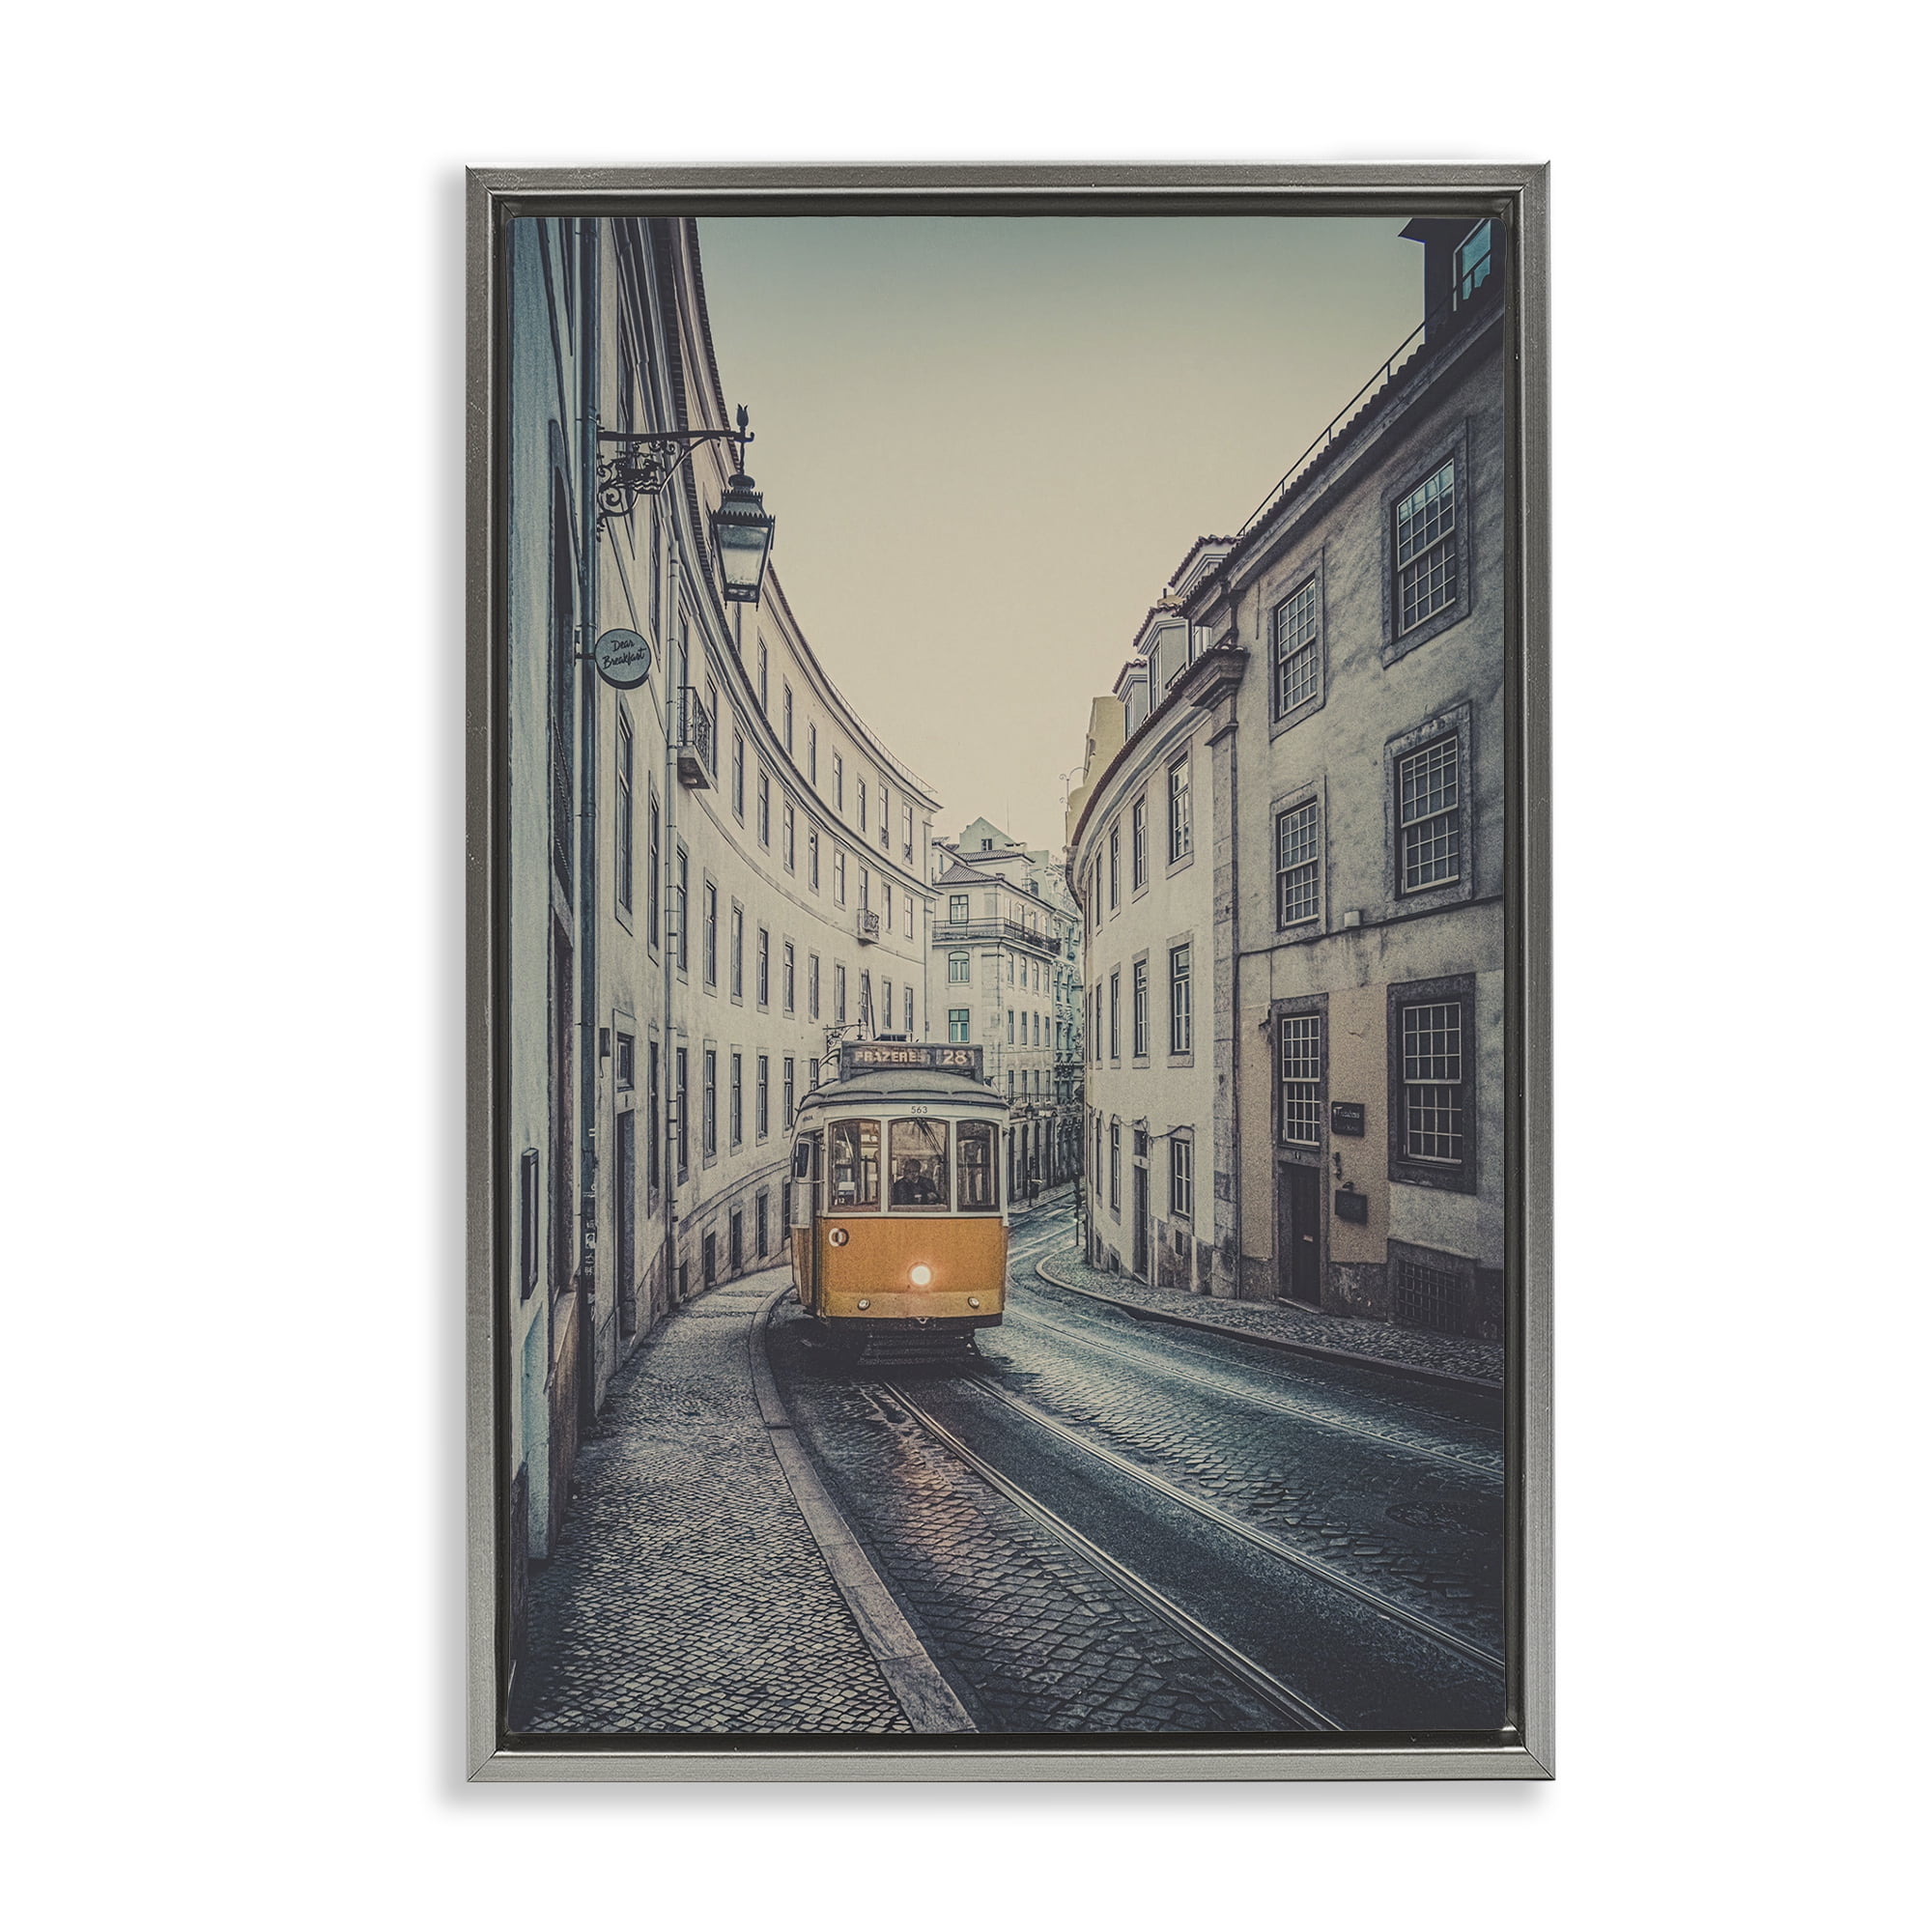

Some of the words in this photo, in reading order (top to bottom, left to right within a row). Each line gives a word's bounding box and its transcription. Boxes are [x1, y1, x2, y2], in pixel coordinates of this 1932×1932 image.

[611, 639, 635, 652] Dear
[603, 648, 647, 669] Breakfast
[911, 1105, 928, 1115] 563
